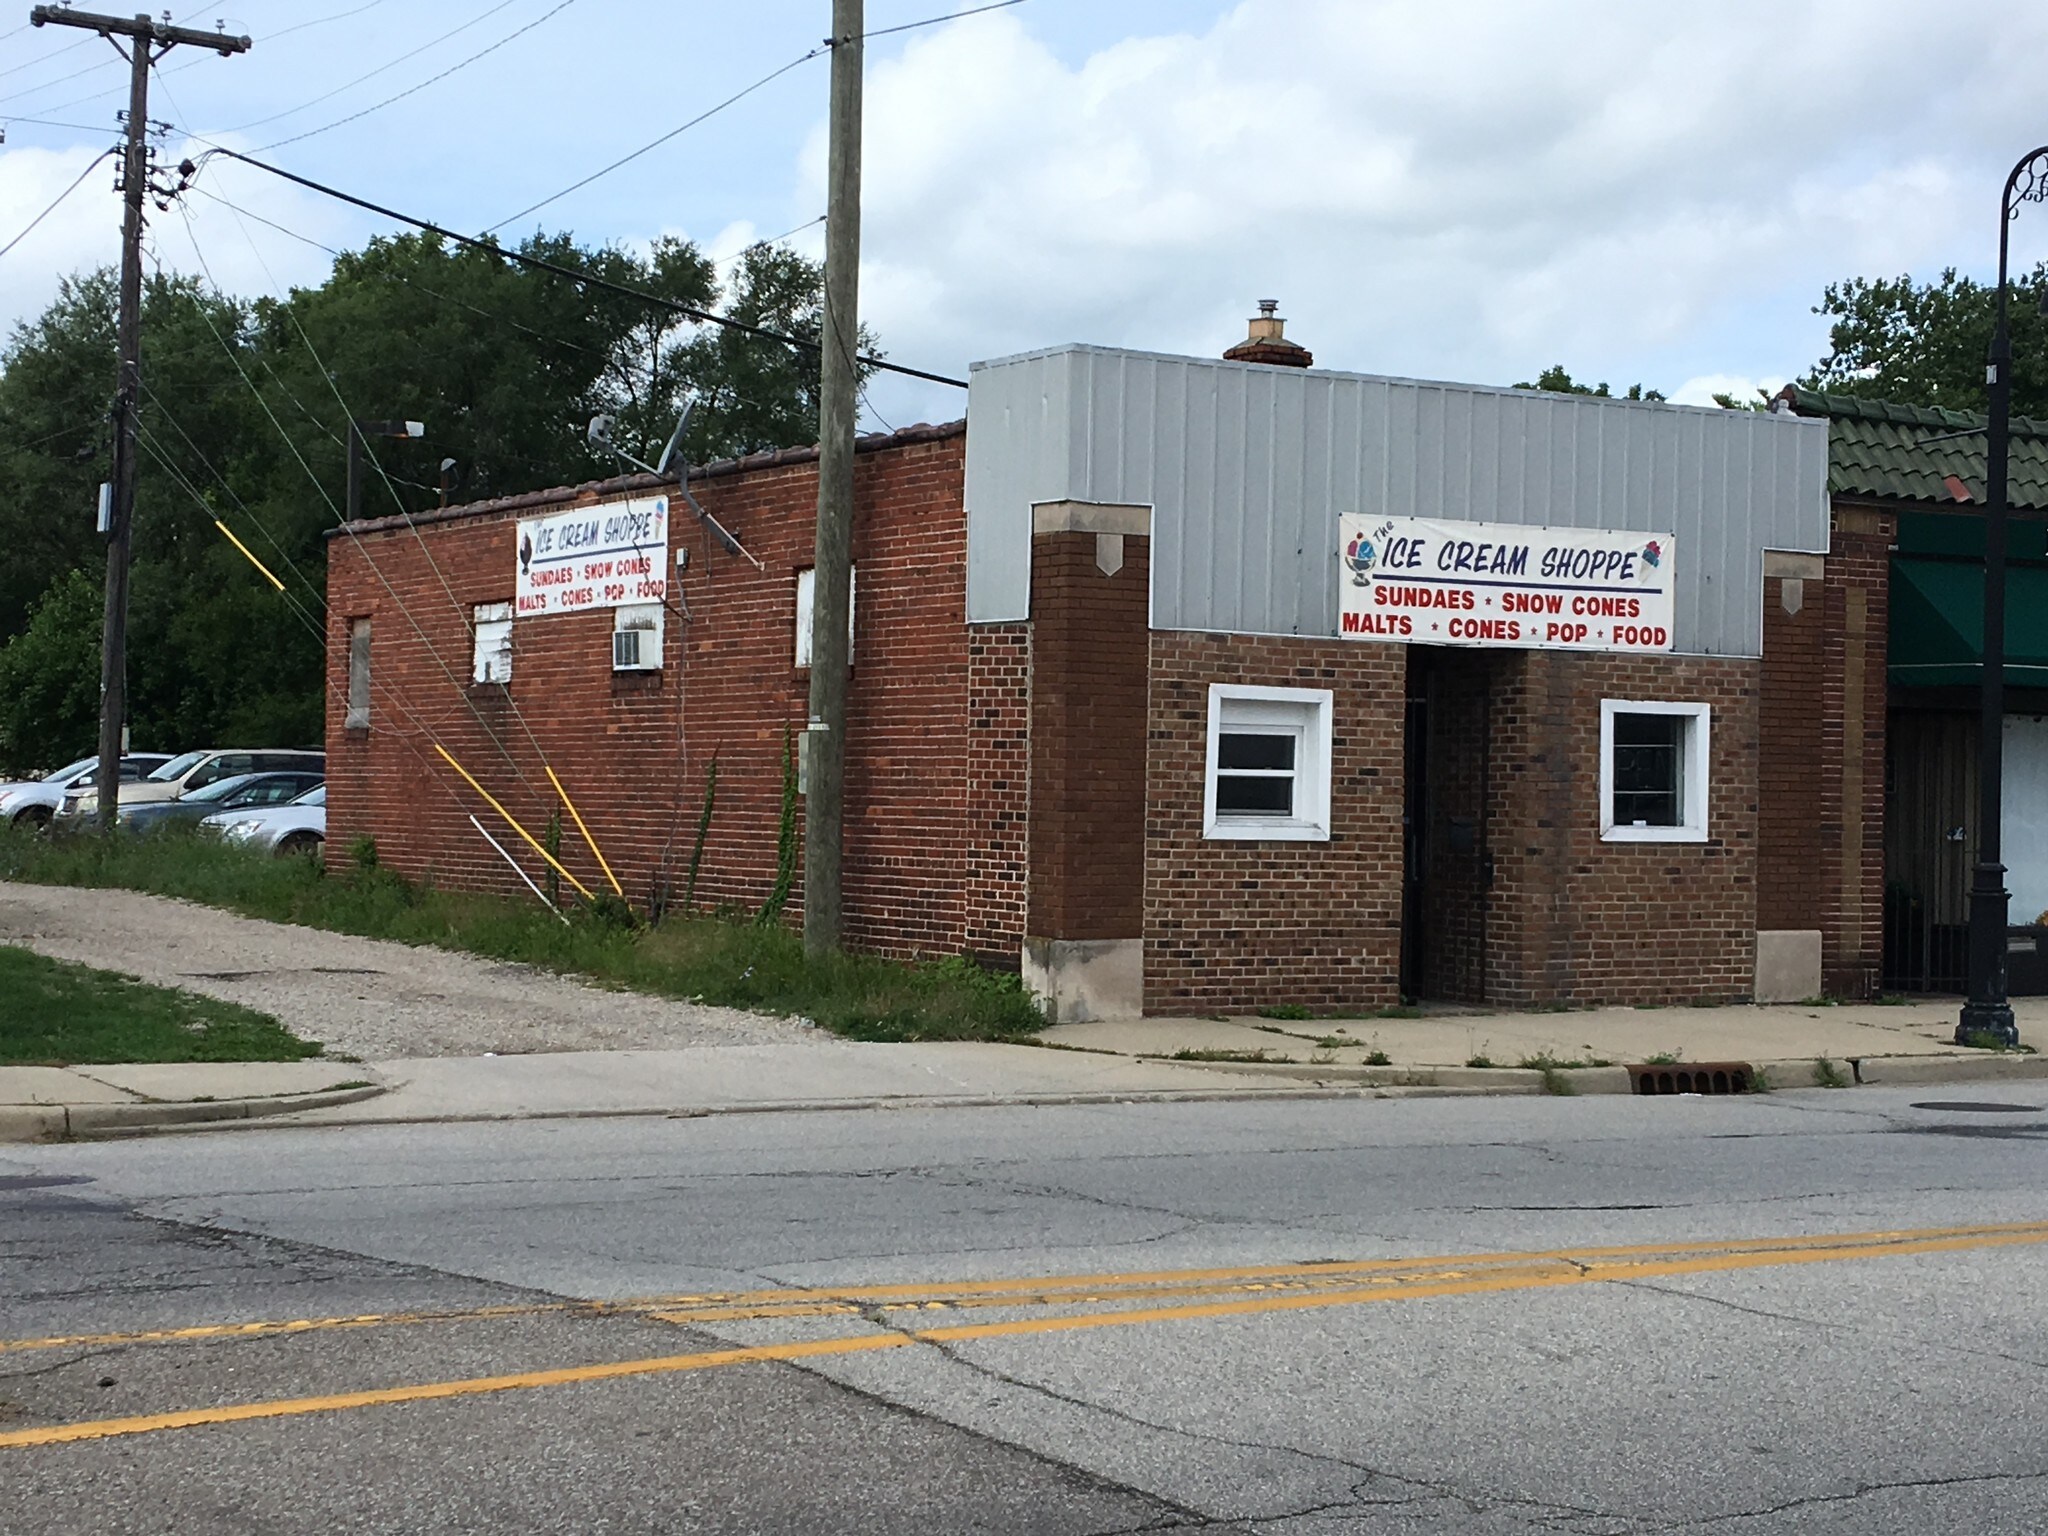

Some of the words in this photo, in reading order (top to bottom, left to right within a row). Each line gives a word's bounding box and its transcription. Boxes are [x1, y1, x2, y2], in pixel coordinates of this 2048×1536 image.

[535, 528, 554, 554] ICE
[558, 520, 600, 551] CREAM
[604, 512, 652, 544] SHOPPE
[1371, 520, 1395, 544] The
[530, 566, 573, 587] SUNDAES
[584, 561, 613, 580] SNOW
[616, 556, 651, 577] CONES
[1381, 536, 1426, 569] ICE
[1437, 539, 1530, 576] CREAM
[1540, 547, 1638, 580] SHOPPE
[518, 594, 547, 611] MALTS
[561, 587, 593, 606] CONES
[604, 584, 625, 600] POP
[637, 579, 664, 597] FOOD
[1374, 585, 1475, 610] SUNDAES
[1501, 592, 1563, 614] SNOW
[1571, 596, 1640, 618] CONES
[1342, 612, 1413, 635] MALTS
[1448, 617, 1521, 640] CONES
[1546, 622, 1588, 643] POP
[1612, 625, 1667, 646] FOOD
